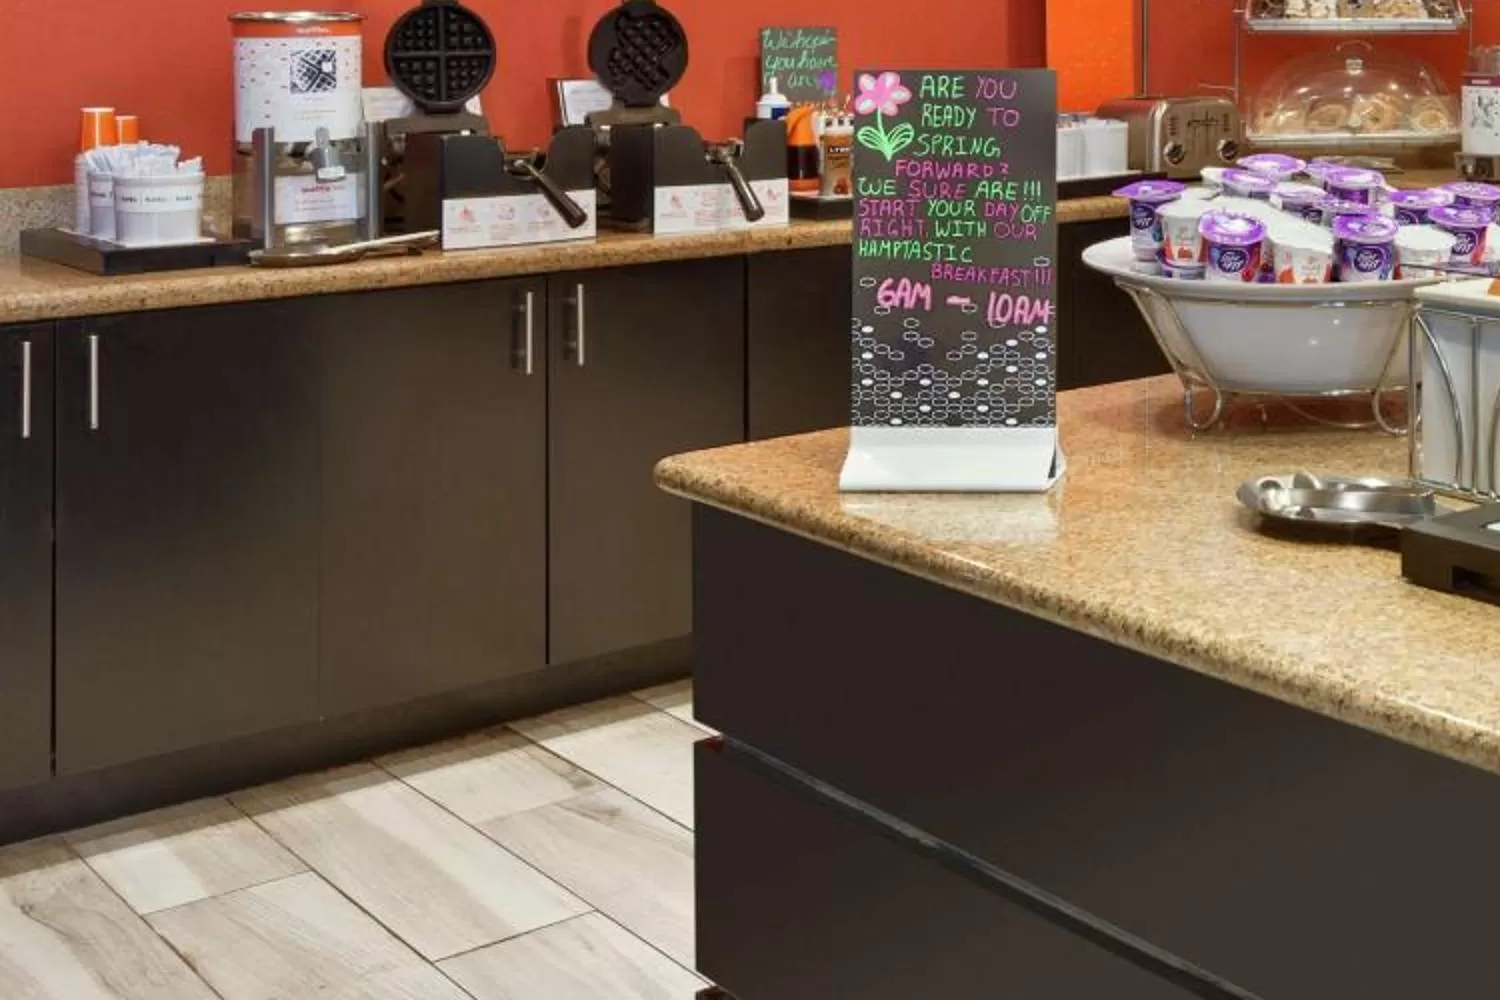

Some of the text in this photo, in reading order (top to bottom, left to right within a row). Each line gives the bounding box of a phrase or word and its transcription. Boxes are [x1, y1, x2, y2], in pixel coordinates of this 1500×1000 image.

[919, 75, 1018, 100] ARE YOU
[921, 103, 1021, 129] READY TO
[913, 133, 1001, 157] SPRING
[857, 176, 897, 196] WE
[907, 179, 967, 202] SURE
[859, 200, 1052, 225] START YOUR DAY OFF
[935, 220, 987, 238] WITH
[994, 222, 1038, 240] OUR
[859, 240, 973, 263] HAMPTASTIC
[877, 277, 932, 311] 6AM
[987, 291, 1052, 325] 10AM
